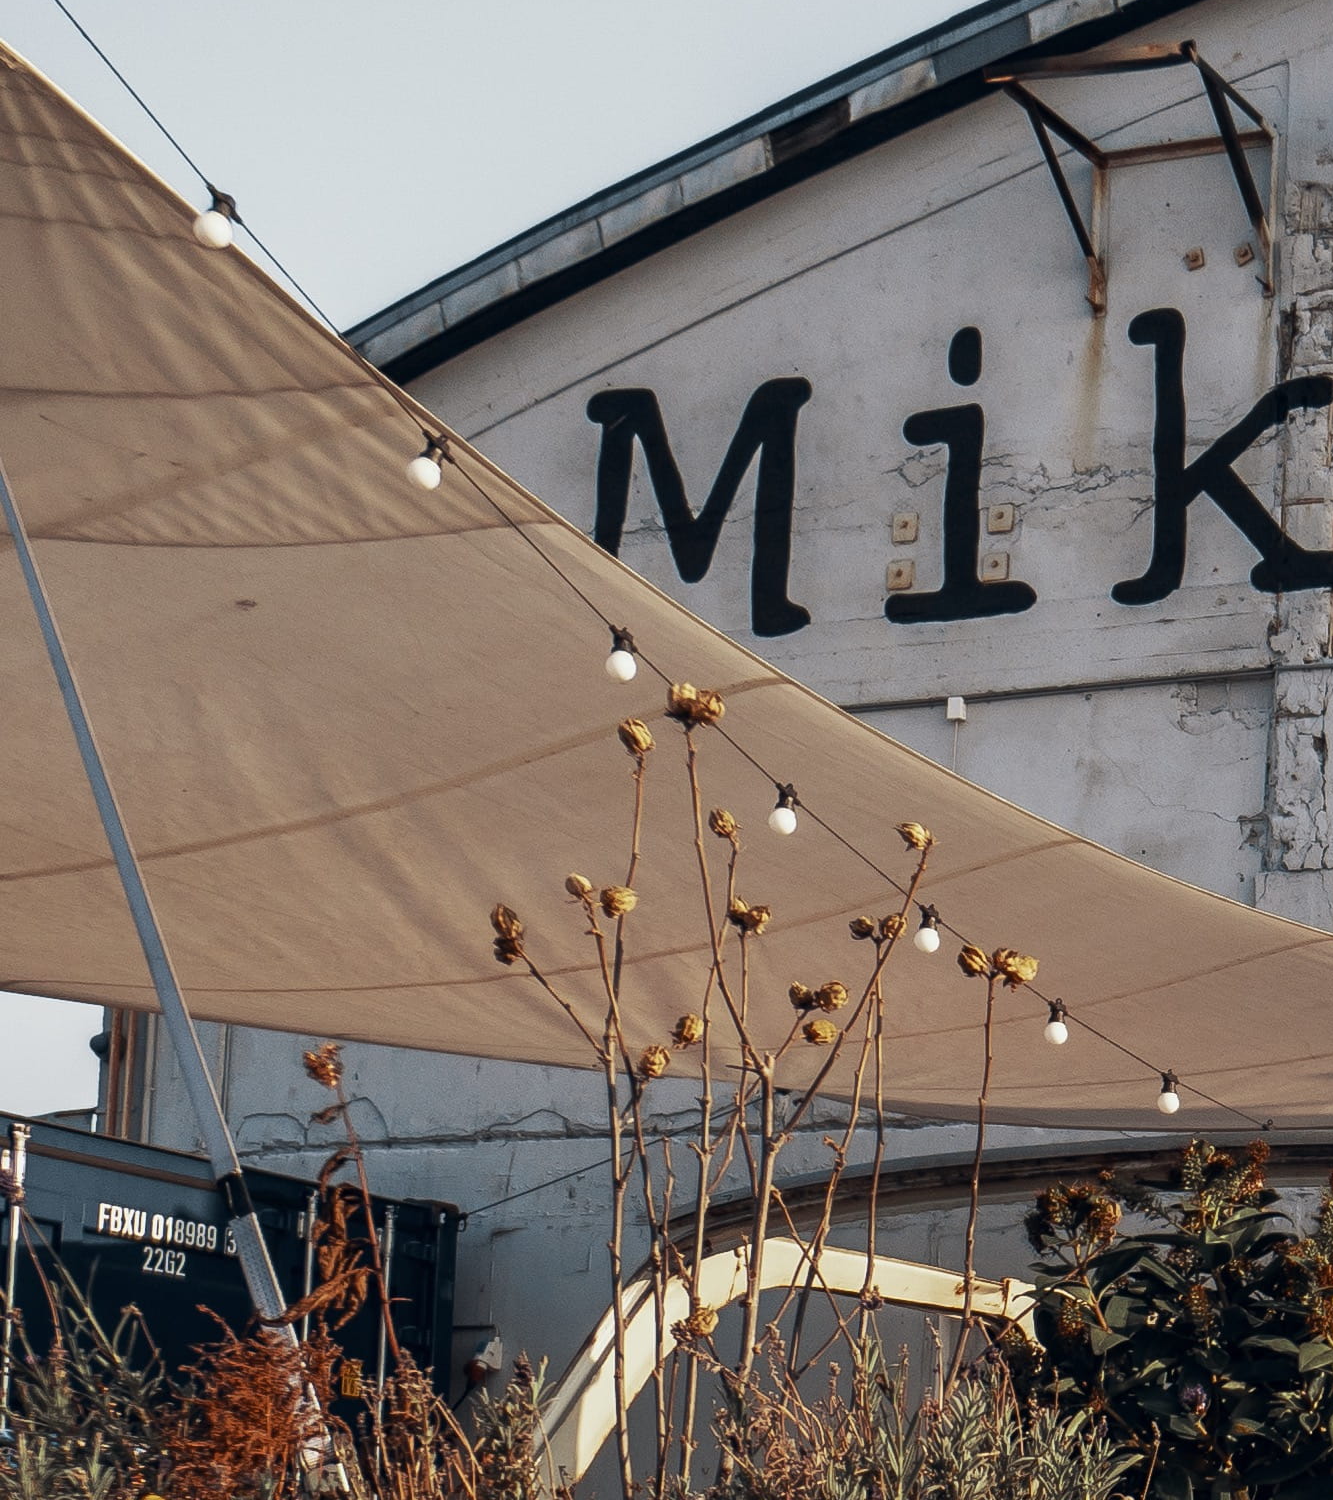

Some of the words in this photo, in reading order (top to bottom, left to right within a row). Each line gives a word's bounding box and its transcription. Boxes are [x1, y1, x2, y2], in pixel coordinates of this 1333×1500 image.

[99, 1203, 147, 1237] FBXU
[151, 1214, 217, 1250] 018989
[143, 1246, 186, 1276] 22G2
